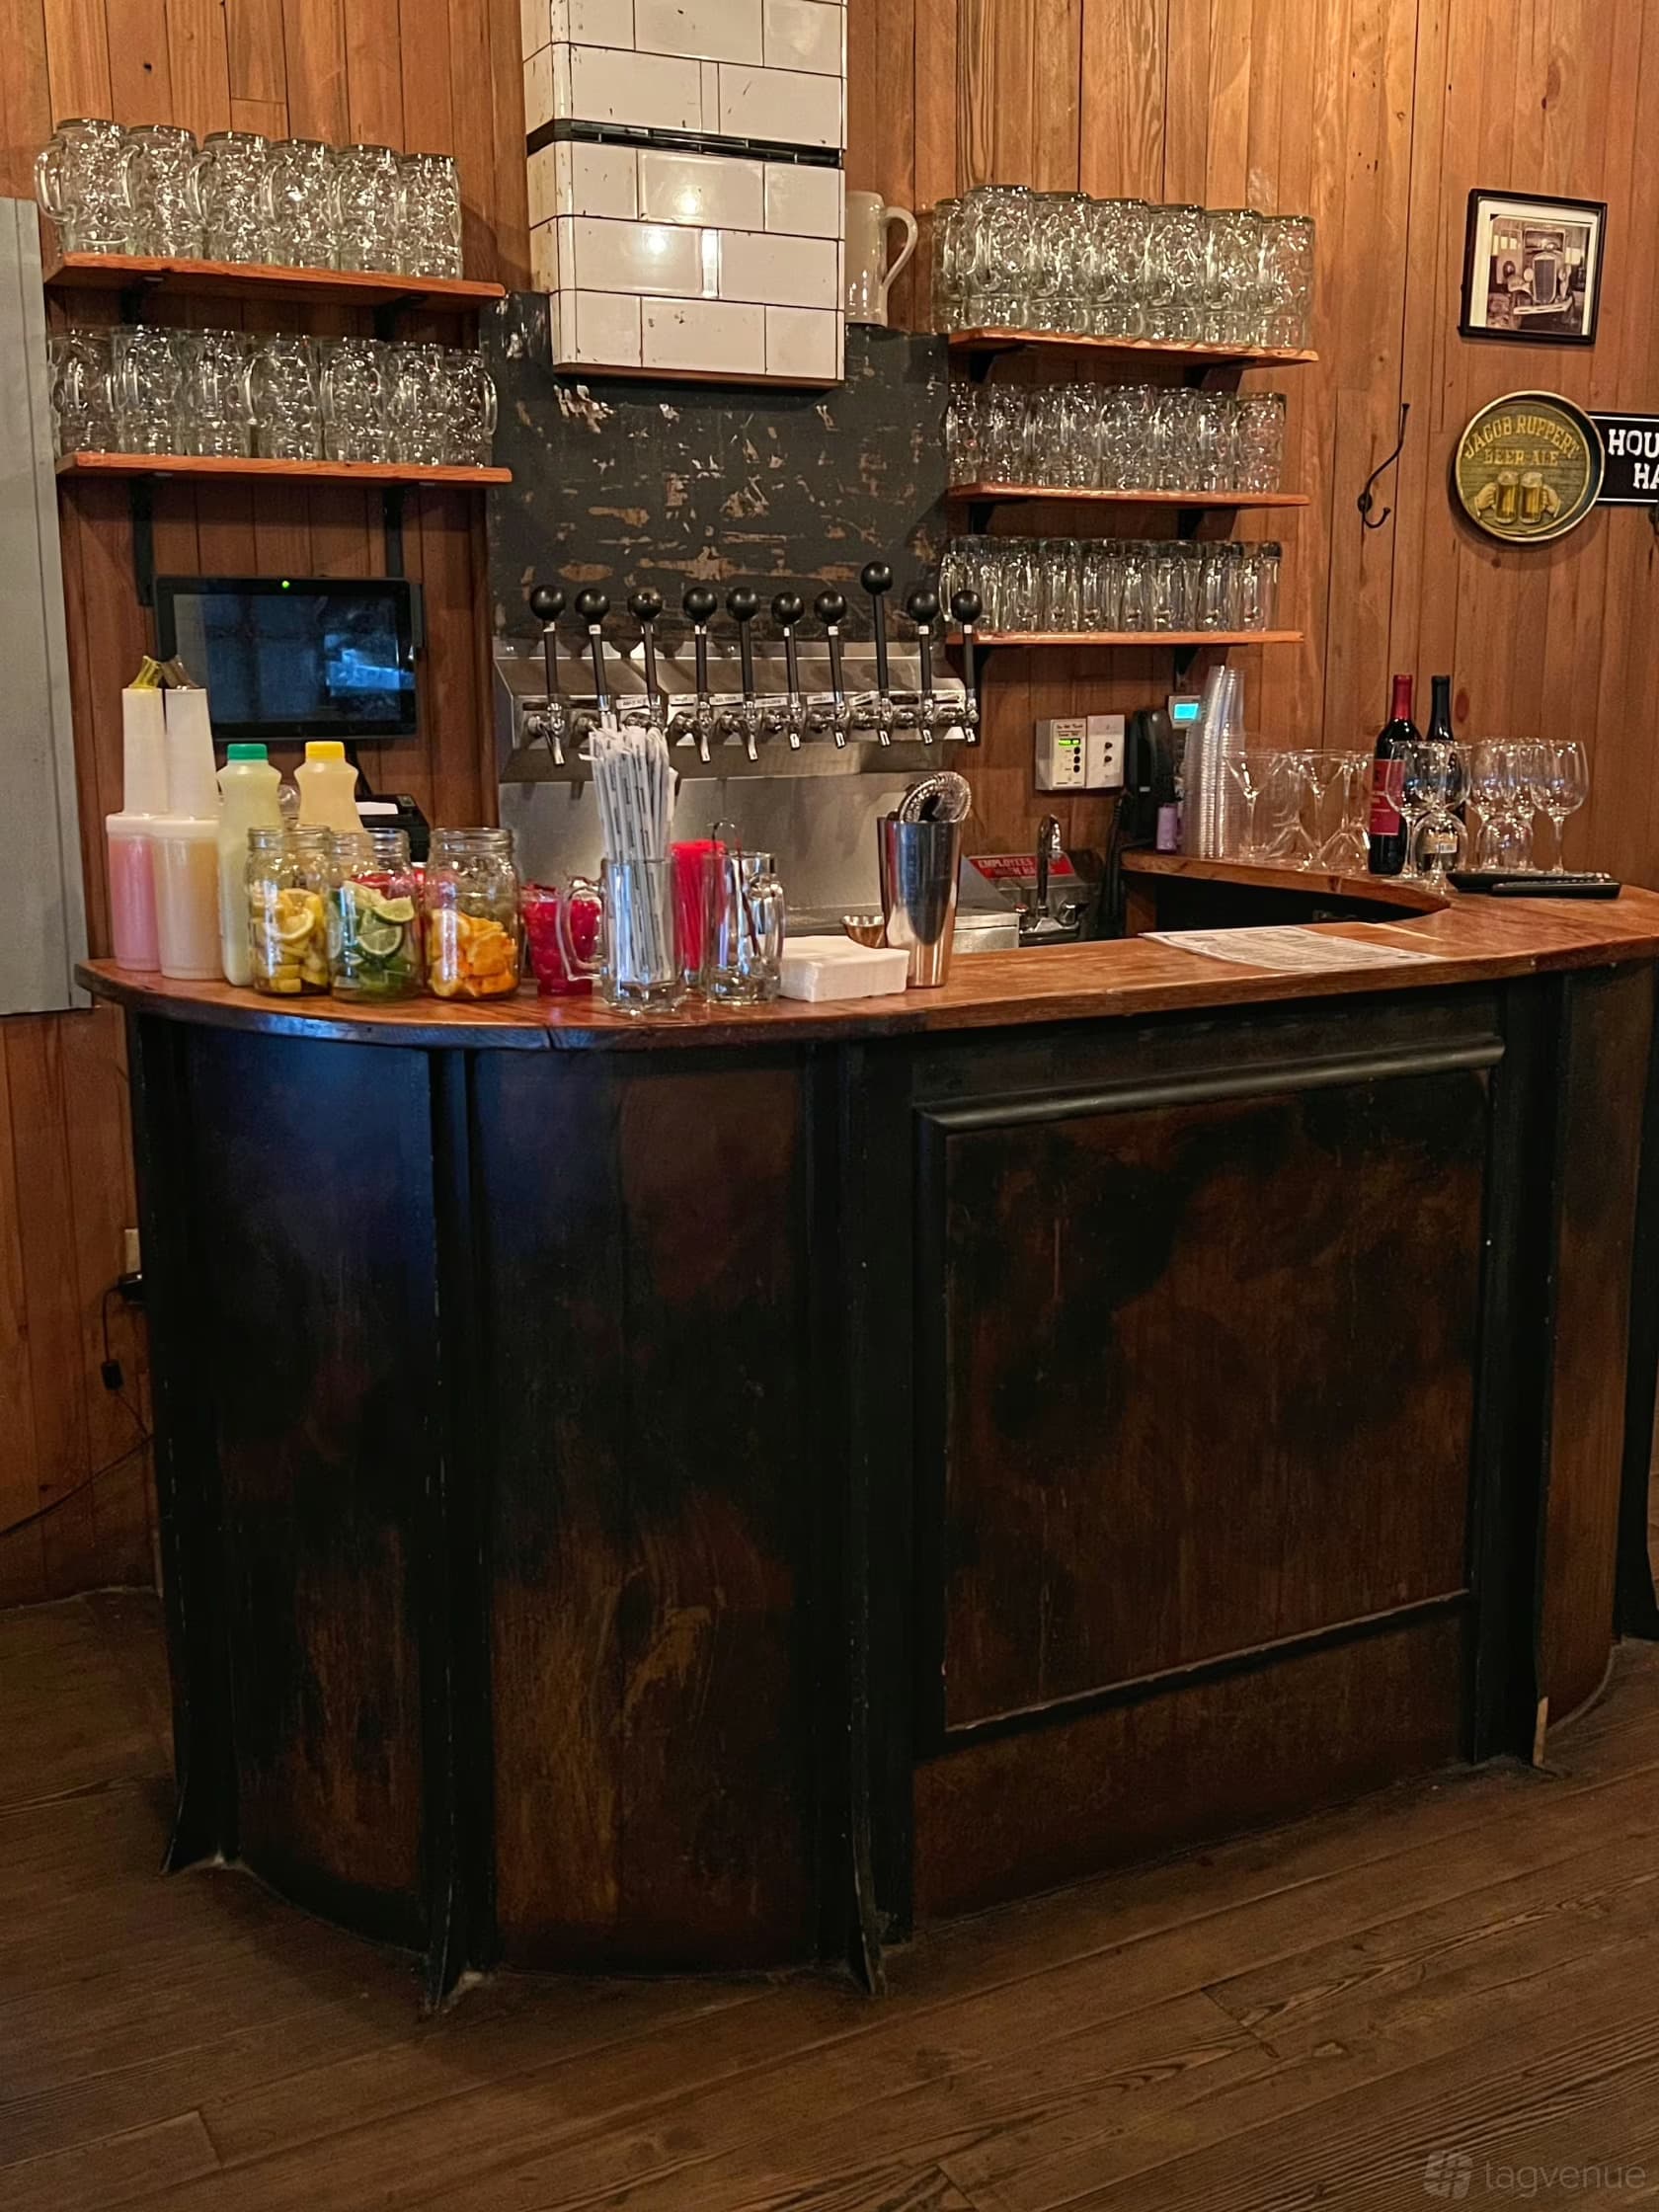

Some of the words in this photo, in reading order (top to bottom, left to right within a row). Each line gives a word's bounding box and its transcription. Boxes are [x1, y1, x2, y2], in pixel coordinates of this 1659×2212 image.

[1464, 416, 1512, 458] JACOB
[1516, 415, 1580, 458] RUPPERT
[1483, 448, 1525, 464] BEER
[1532, 449, 1559, 466] ALE
